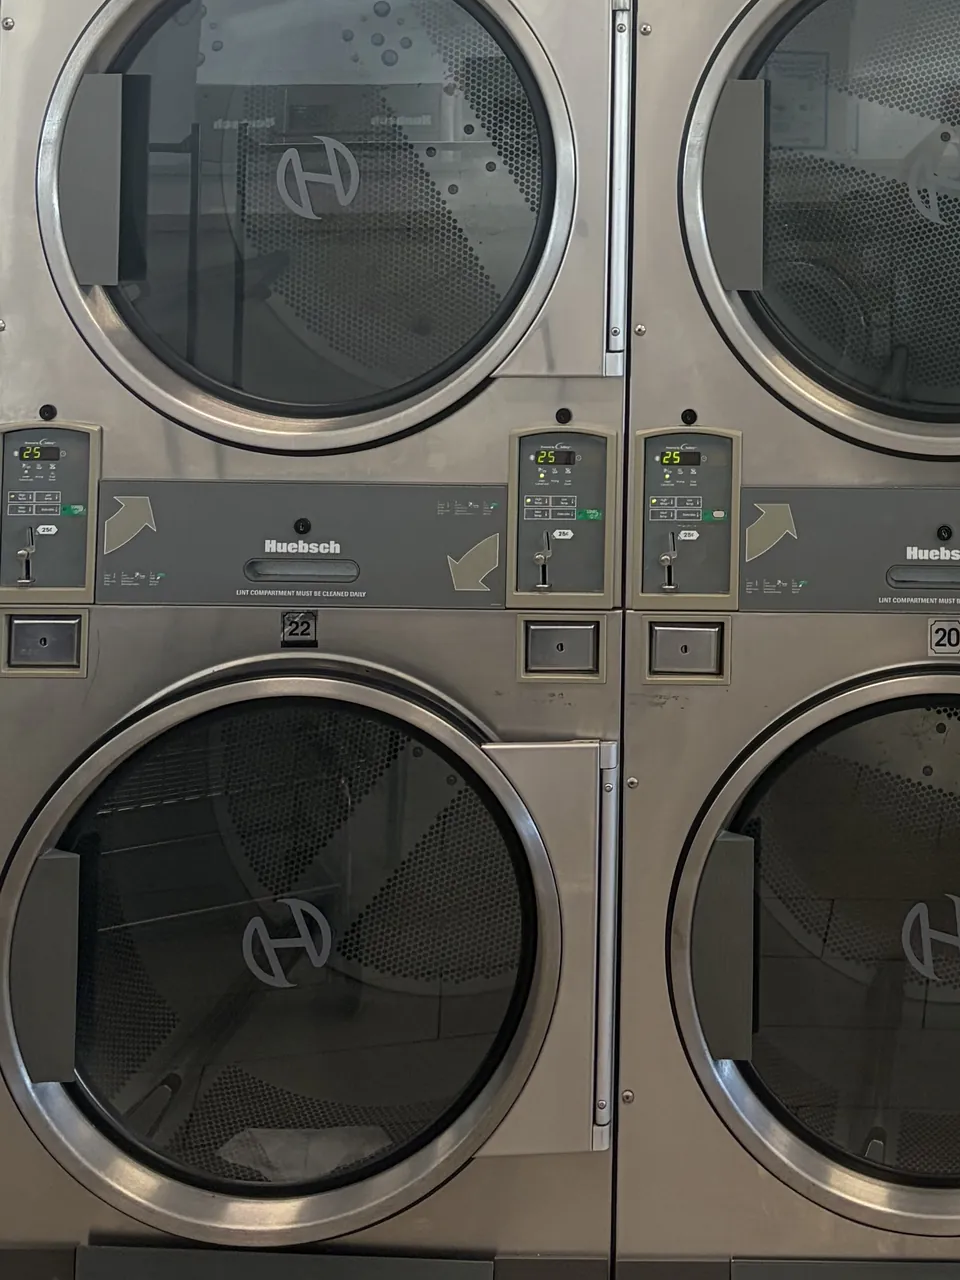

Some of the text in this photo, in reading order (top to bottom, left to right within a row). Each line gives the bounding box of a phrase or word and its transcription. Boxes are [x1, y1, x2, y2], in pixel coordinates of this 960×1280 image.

[22, 446, 41, 459] 25
[537, 450, 556, 463] 25
[662, 451, 681, 464] 25
[264, 539, 341, 554] Huebsch
[250, 589, 295, 597] COMPARTMENT
[938, 597, 955, 605] MUST
[288, 620, 311, 637] 22
[934, 627, 960, 647] 20
